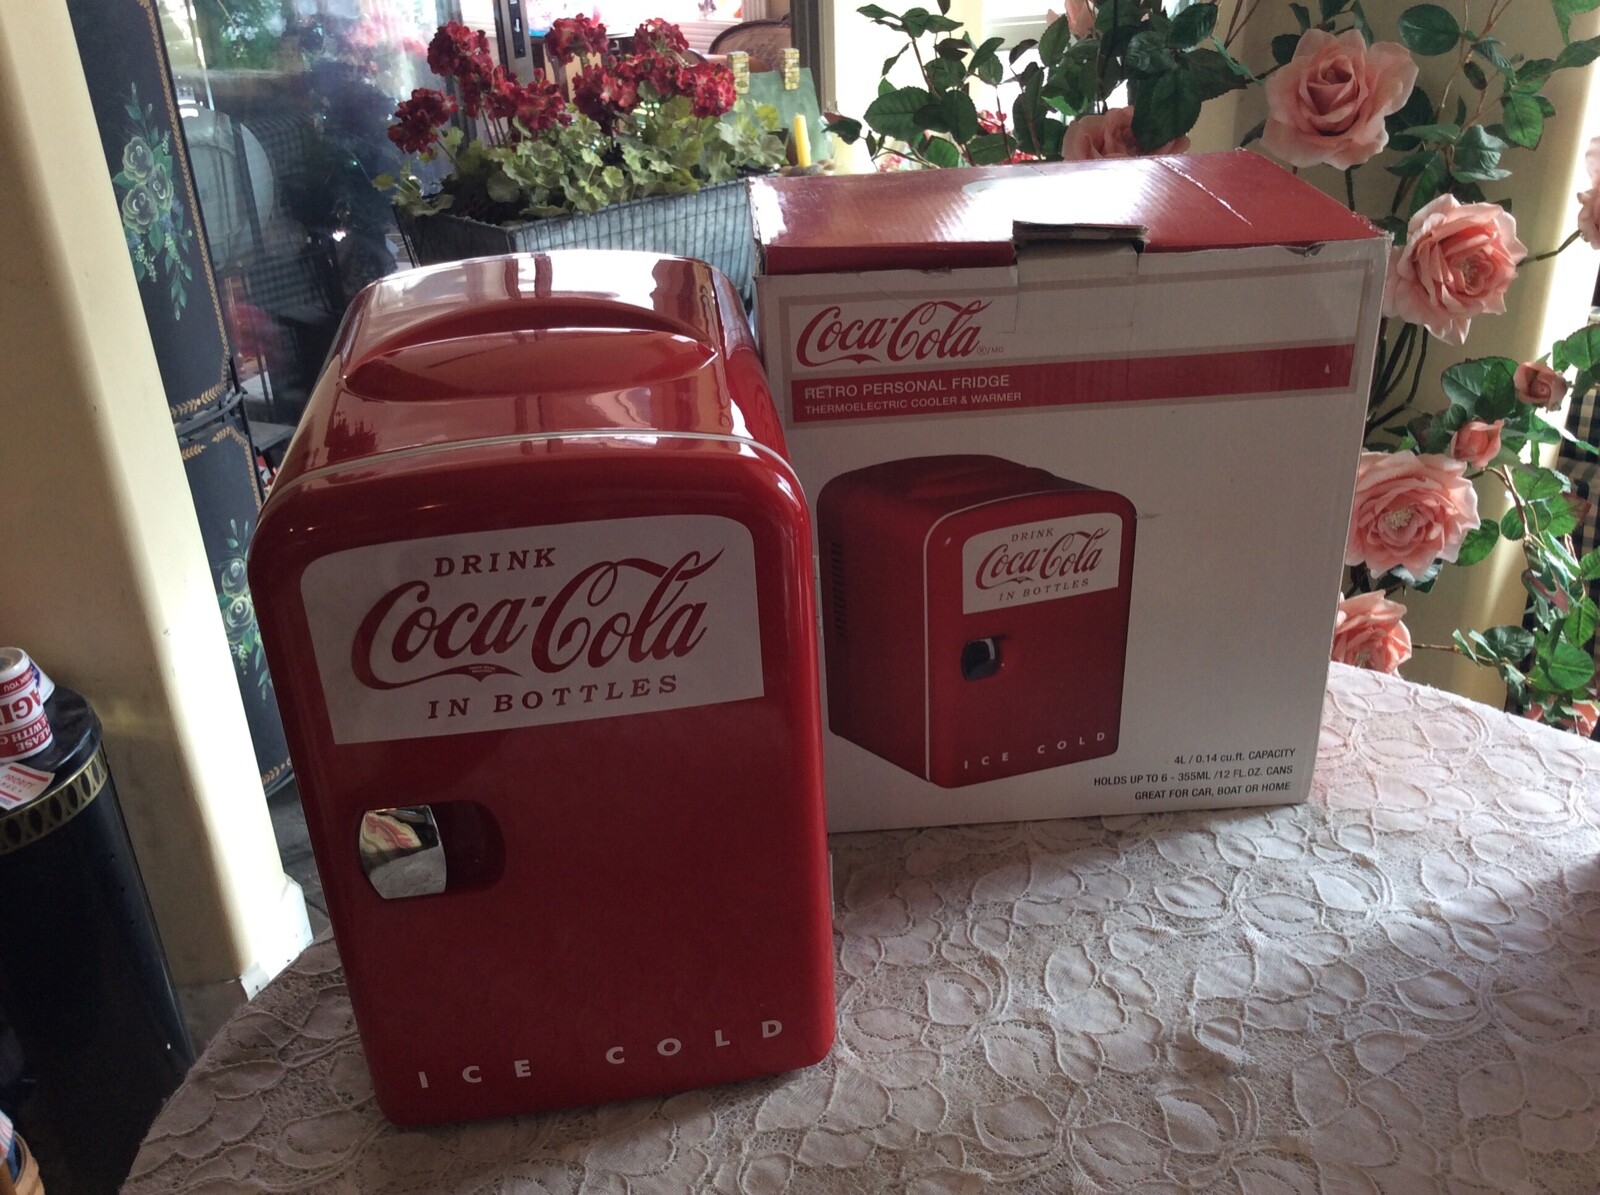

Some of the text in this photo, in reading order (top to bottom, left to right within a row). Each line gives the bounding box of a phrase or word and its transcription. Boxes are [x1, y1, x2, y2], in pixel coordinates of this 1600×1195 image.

[796, 300, 993, 367] Coca-Cola
[804, 374, 1010, 400] RETRO PERSONAL FRIDGE
[804, 392, 1022, 415] THERMOELECTRIC COOLER & WARMER
[1011, 528, 1054, 542] DRINK
[433, 547, 557, 577] DRINK
[975, 527, 1111, 590] Coca-Cola
[999, 578, 1089, 601] IN BOTTLES
[350, 546, 726, 691] Coca-Cola
[3, 681, 20, 692] YOU
[427, 674, 677, 720] IN BOTTLES
[11, 721, 42, 742] WITH
[964, 732, 1105, 769] ICE COLD
[1174, 755, 1185, 764] 4L
[1195, 754, 1217, 763] 0.14
[1248, 748, 1296, 760] CAPACITY
[1094, 776, 1127, 786] HOLDS
[1130, 775, 1143, 784] UP
[1146, 774, 1158, 783] TO
[1161, 773, 1168, 782] 6
[1178, 771, 1211, 782] 355ML
[1266, 765, 1294, 776] CANS
[1134, 782, 1291, 800] GREAT FOR CAR, BOAT OR HOME
[418, 1019, 783, 1089] ICE COLD
